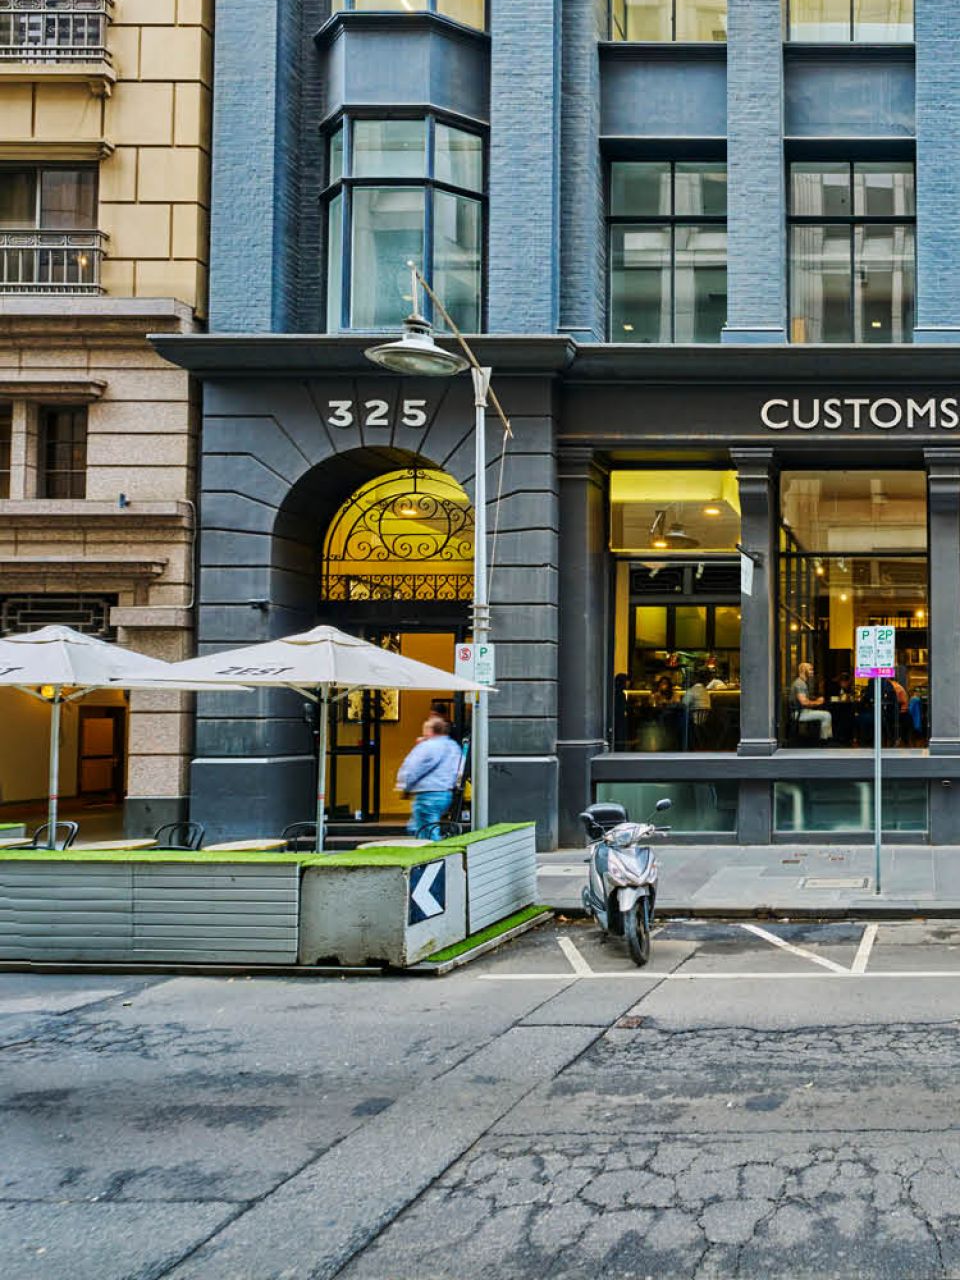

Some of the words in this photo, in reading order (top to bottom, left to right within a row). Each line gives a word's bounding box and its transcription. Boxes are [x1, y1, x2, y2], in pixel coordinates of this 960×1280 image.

[328, 400, 426, 426] 325
[760, 398, 959, 429] CUSTOMS
[862, 630, 870, 641] P
[878, 629, 893, 641] 2P
[480, 647, 488, 658] P
[215, 666, 296, 676] ZEST
